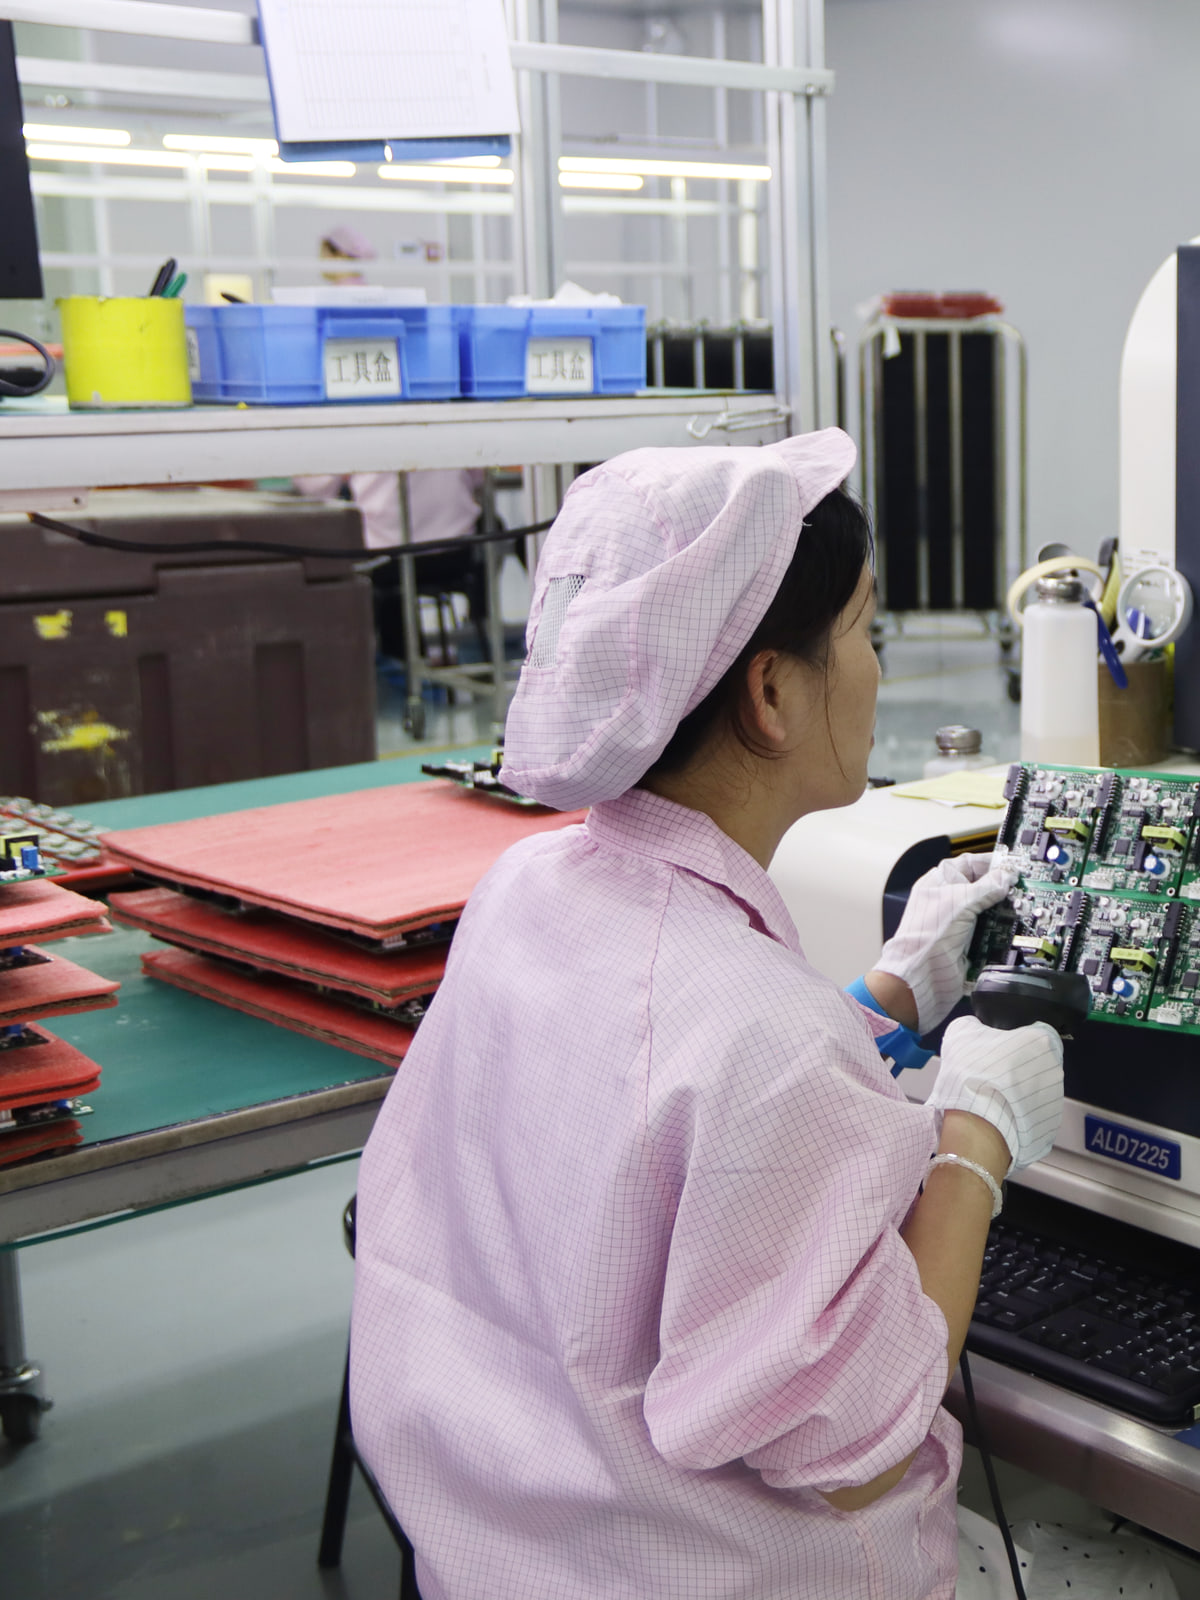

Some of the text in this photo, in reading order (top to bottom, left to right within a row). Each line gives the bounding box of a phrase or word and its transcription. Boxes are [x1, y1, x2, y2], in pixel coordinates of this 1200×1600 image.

[331, 351, 392, 384] 工具盒
[531, 349, 586, 382] 工具盒
[1090, 1126, 1171, 1169] ALD7225
